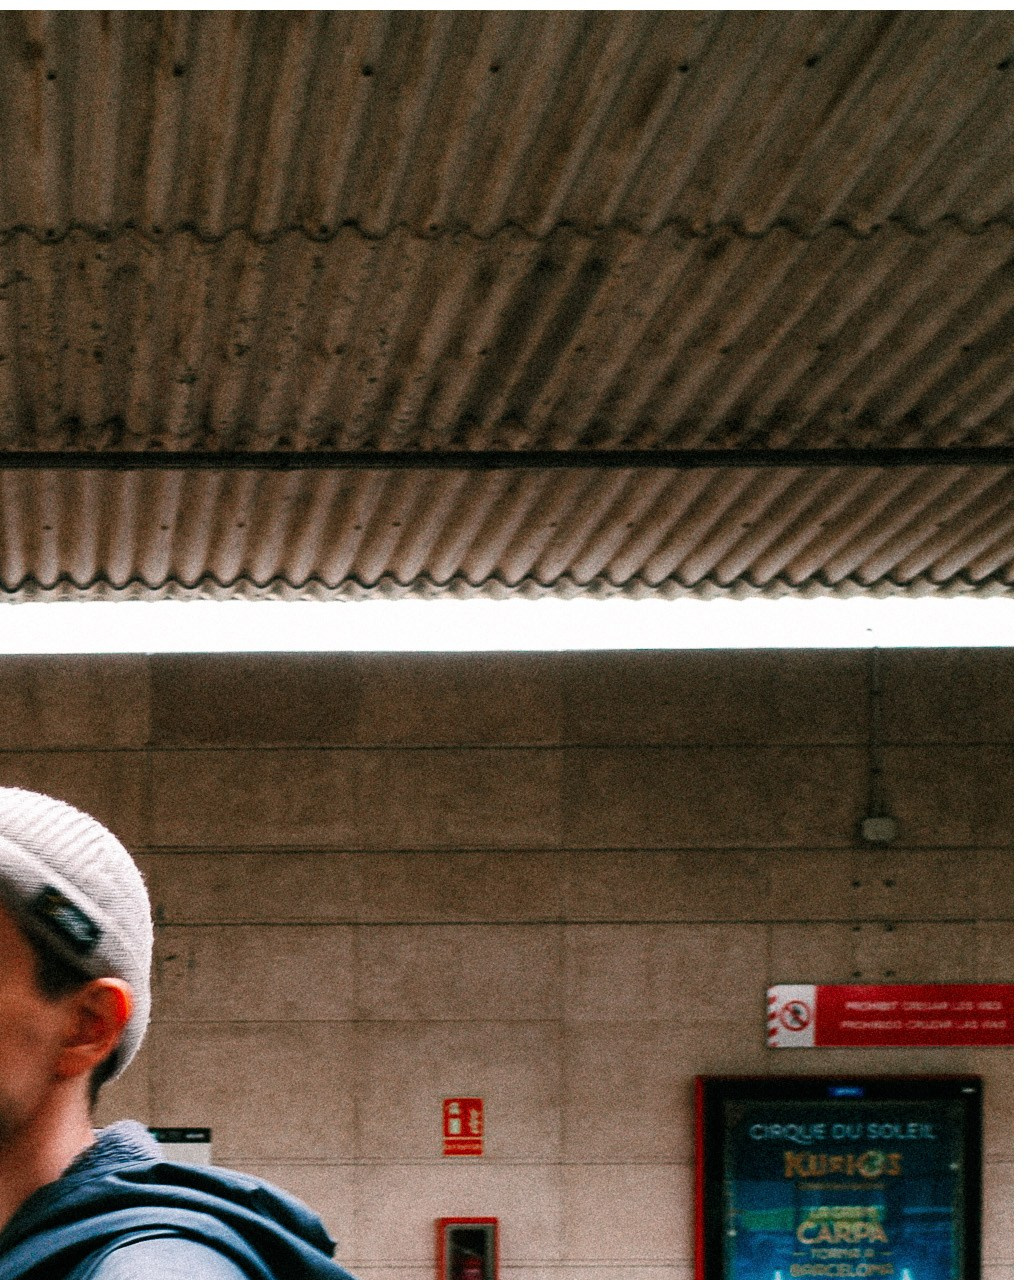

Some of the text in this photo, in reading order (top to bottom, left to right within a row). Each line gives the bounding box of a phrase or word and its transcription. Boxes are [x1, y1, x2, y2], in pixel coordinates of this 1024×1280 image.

[749, 1122, 936, 1145] CIRQUE DU SOLEIL
[796, 1221, 887, 1244] CARPA
